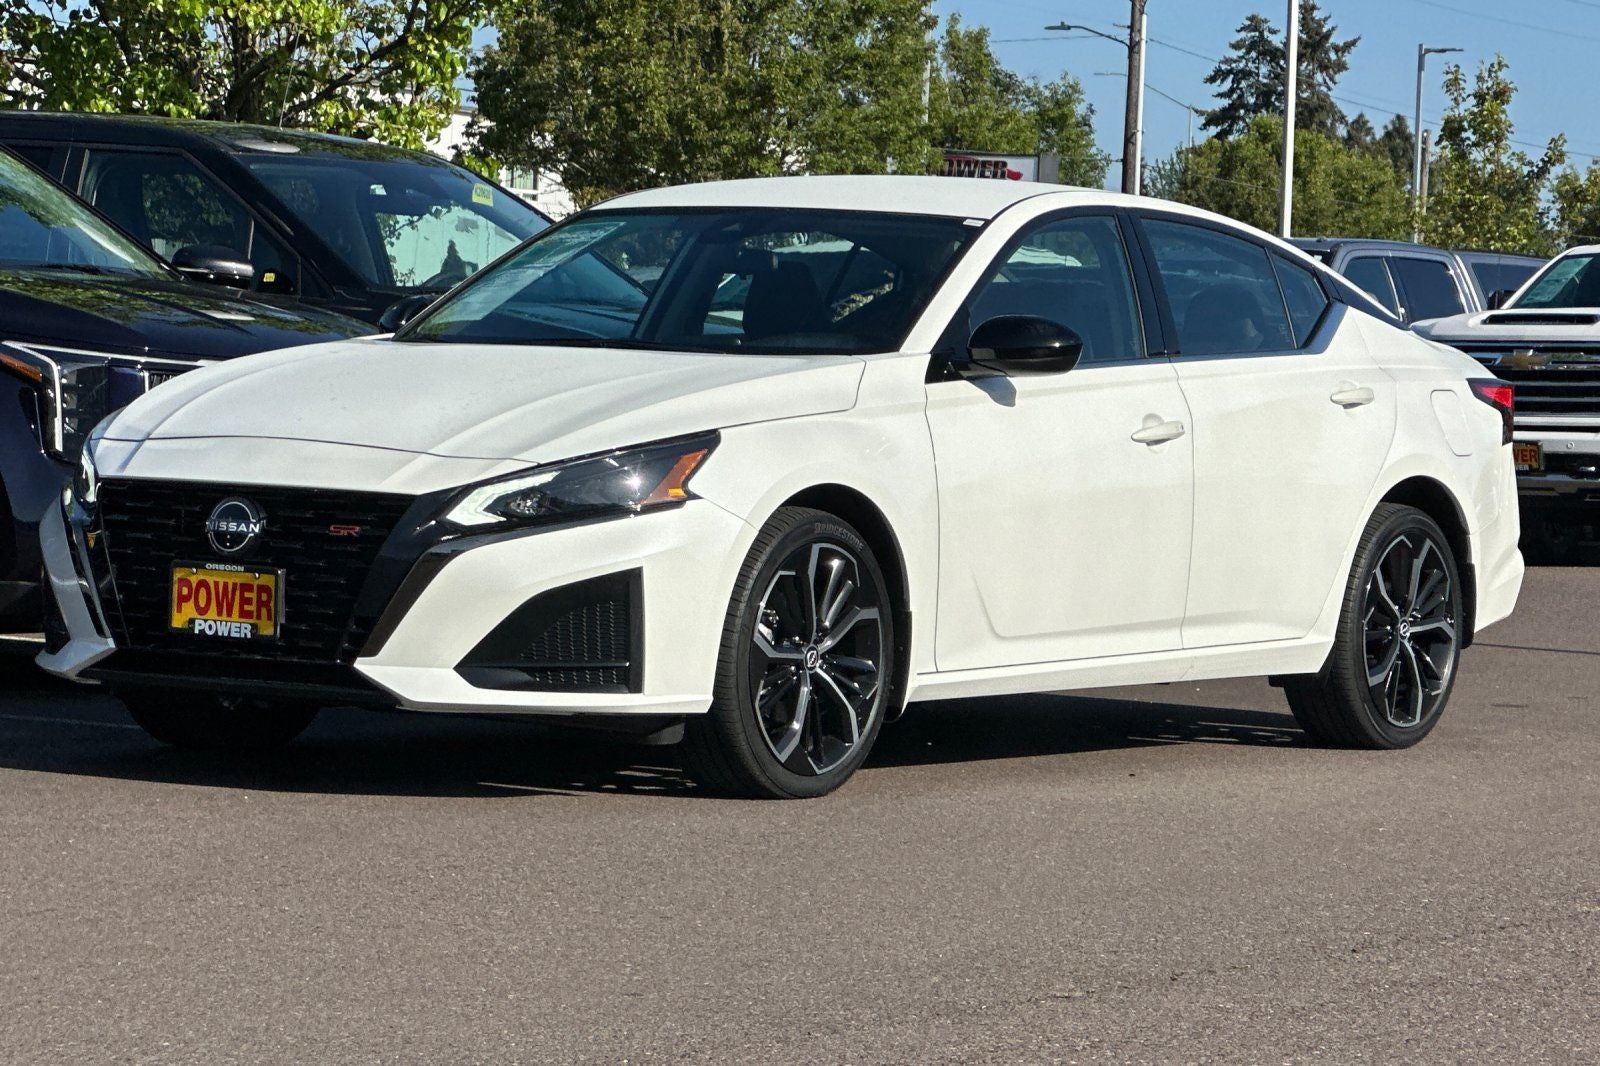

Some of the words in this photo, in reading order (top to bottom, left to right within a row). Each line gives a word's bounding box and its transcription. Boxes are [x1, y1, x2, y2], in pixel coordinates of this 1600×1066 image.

[1513, 448, 1538, 462] WER
[206, 521, 260, 533] NISSAN
[329, 524, 361, 537] SR
[814, 521, 864, 552] BRIDGESTONE
[205, 563, 245, 572] OREGON
[175, 577, 273, 621] POWER
[194, 619, 251, 639] POWER
